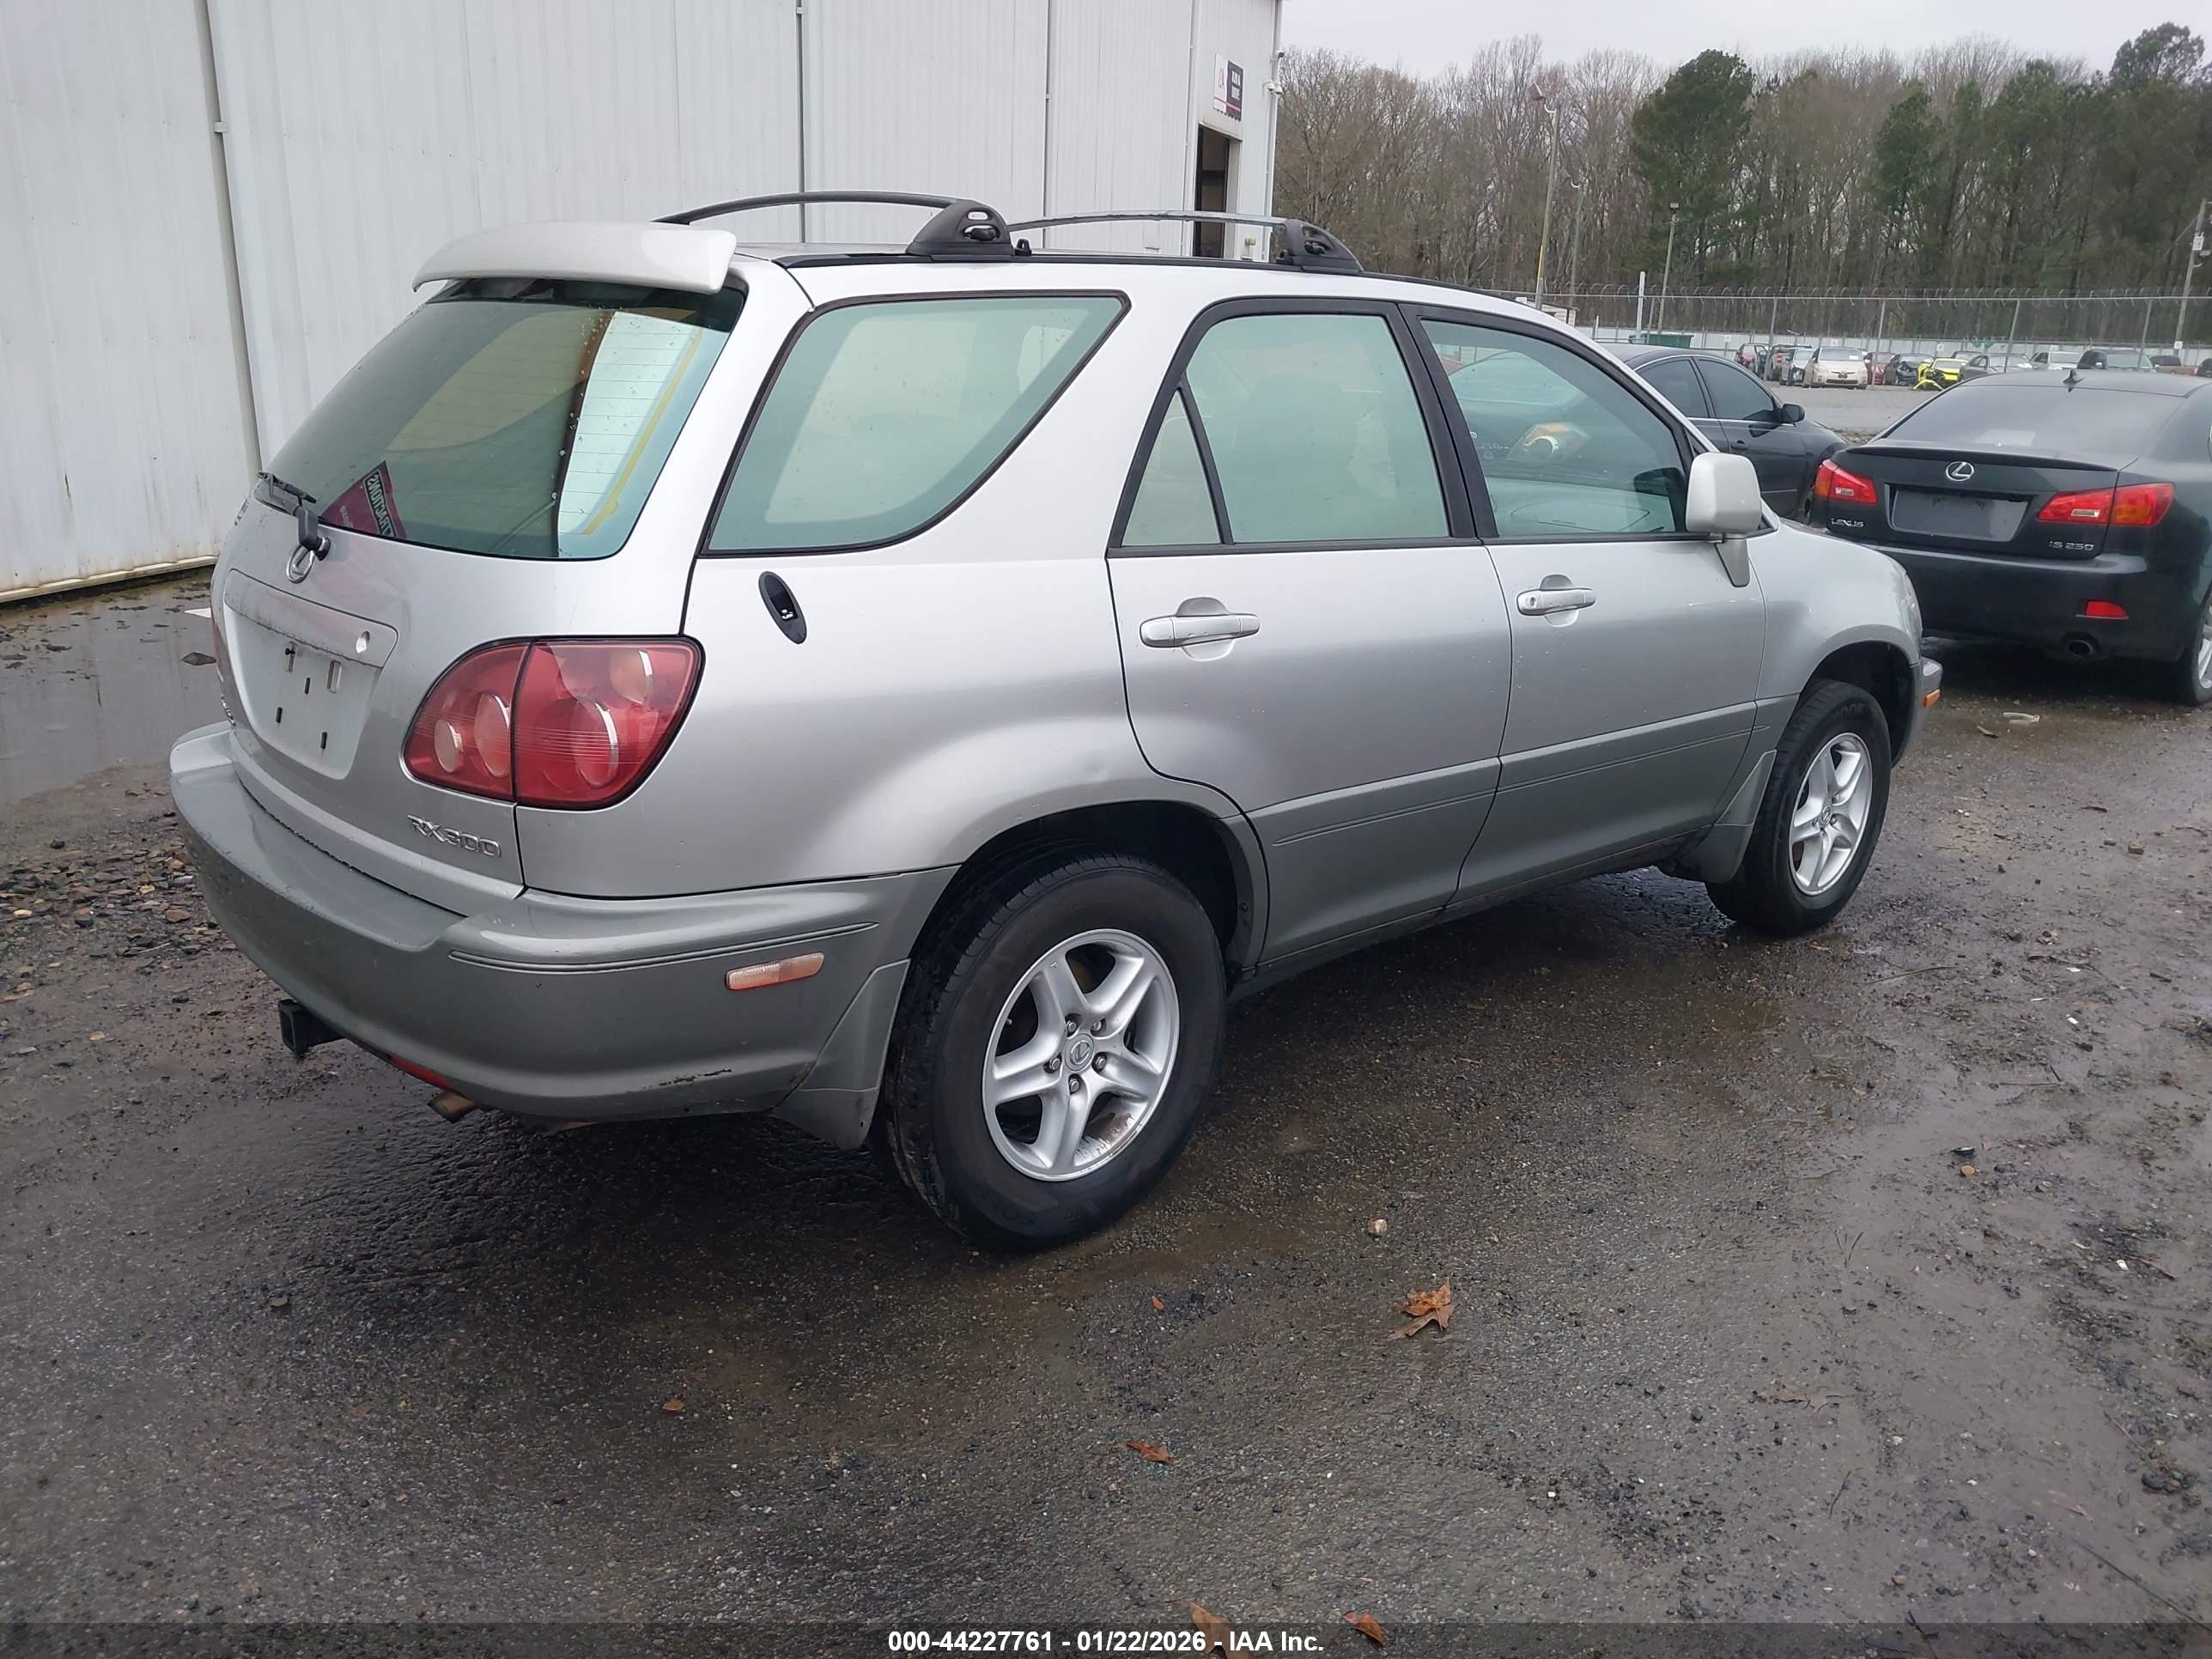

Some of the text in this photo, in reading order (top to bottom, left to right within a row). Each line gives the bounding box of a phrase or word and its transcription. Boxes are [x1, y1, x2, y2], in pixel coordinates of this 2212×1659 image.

[2048, 540, 2094, 551] IS 250
[406, 813, 502, 859] RX300
